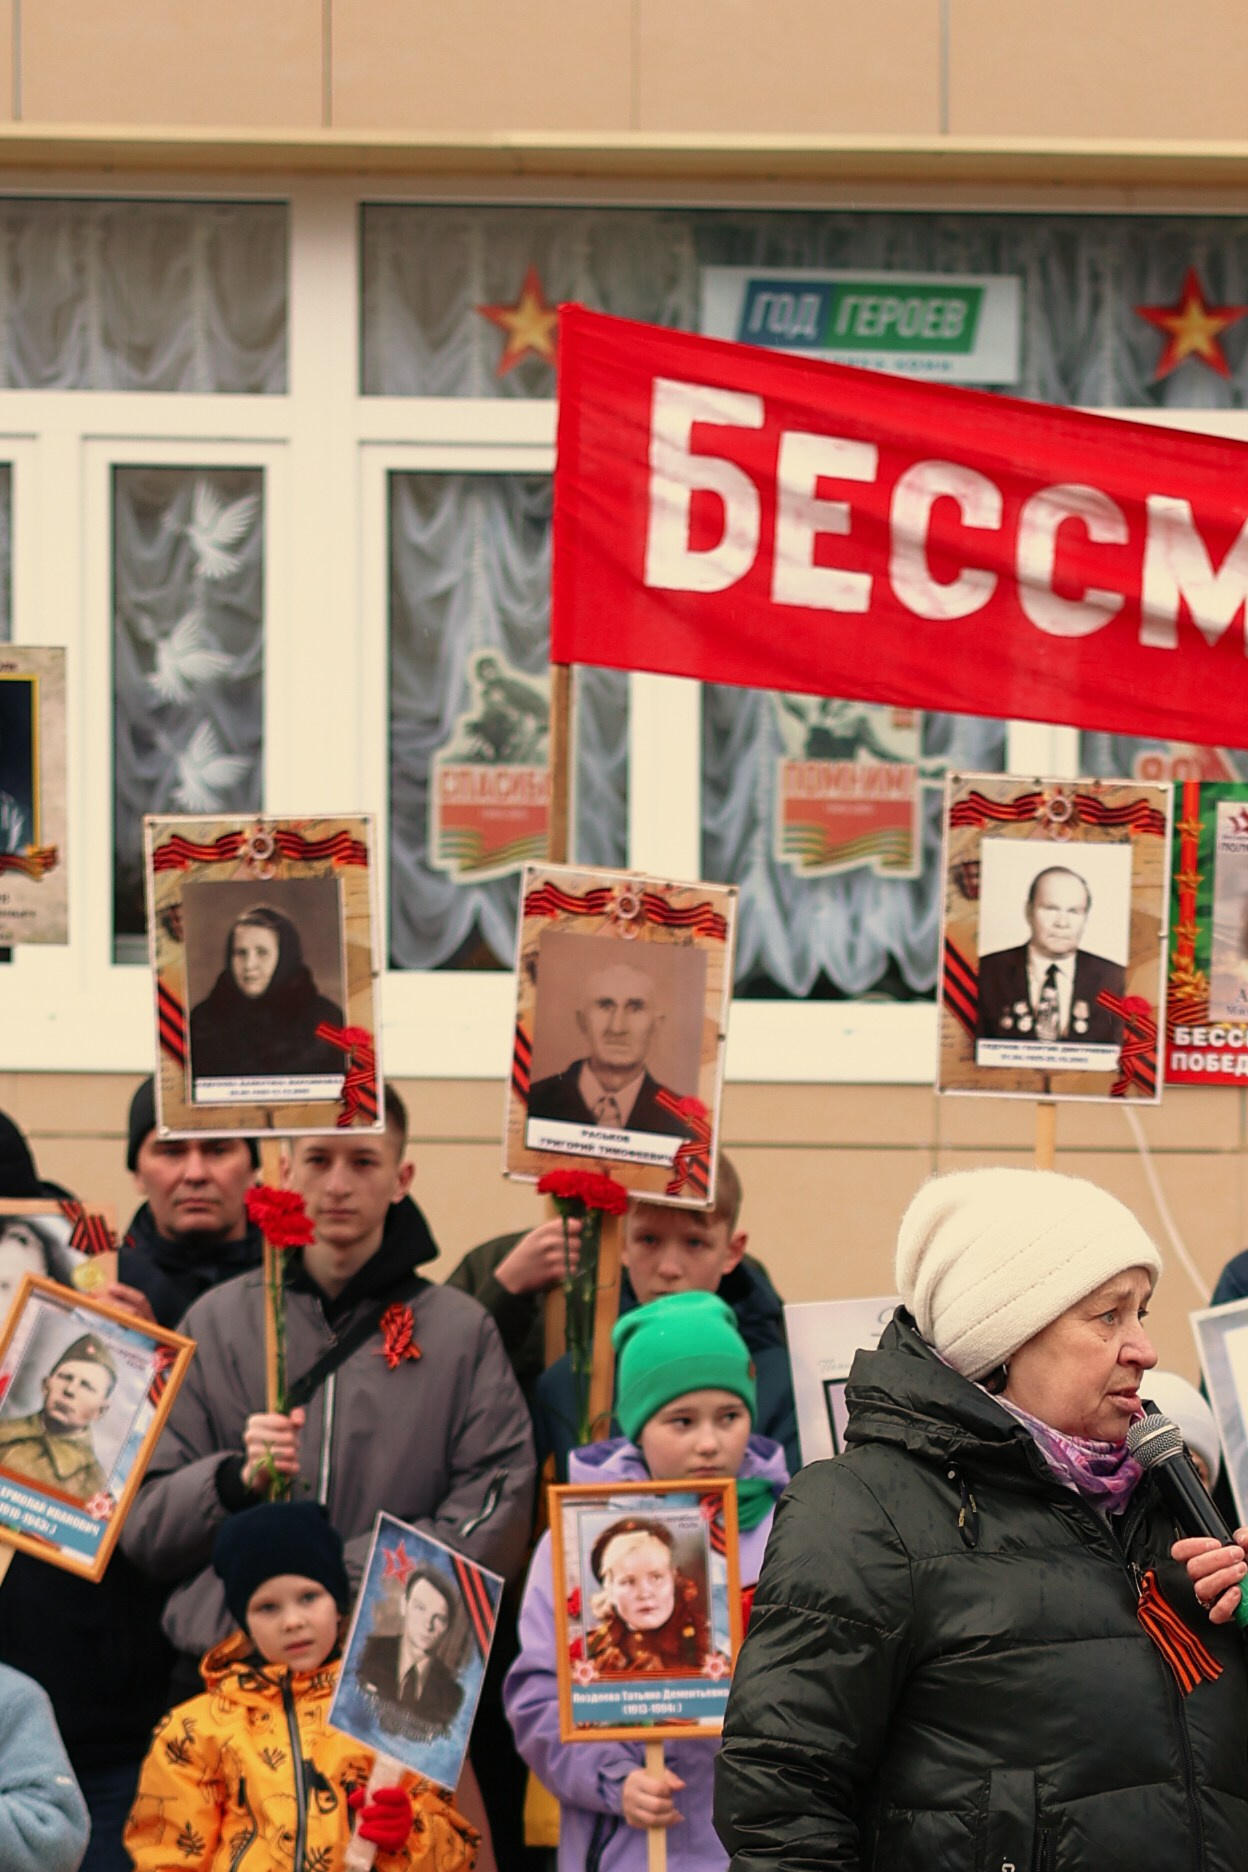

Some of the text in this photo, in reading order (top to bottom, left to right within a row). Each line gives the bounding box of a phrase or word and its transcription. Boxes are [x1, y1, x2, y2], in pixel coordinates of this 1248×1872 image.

[747, 292, 968, 341] ГОД ГЕРОЕВ
[440, 768, 553, 805] СПАСИБ
